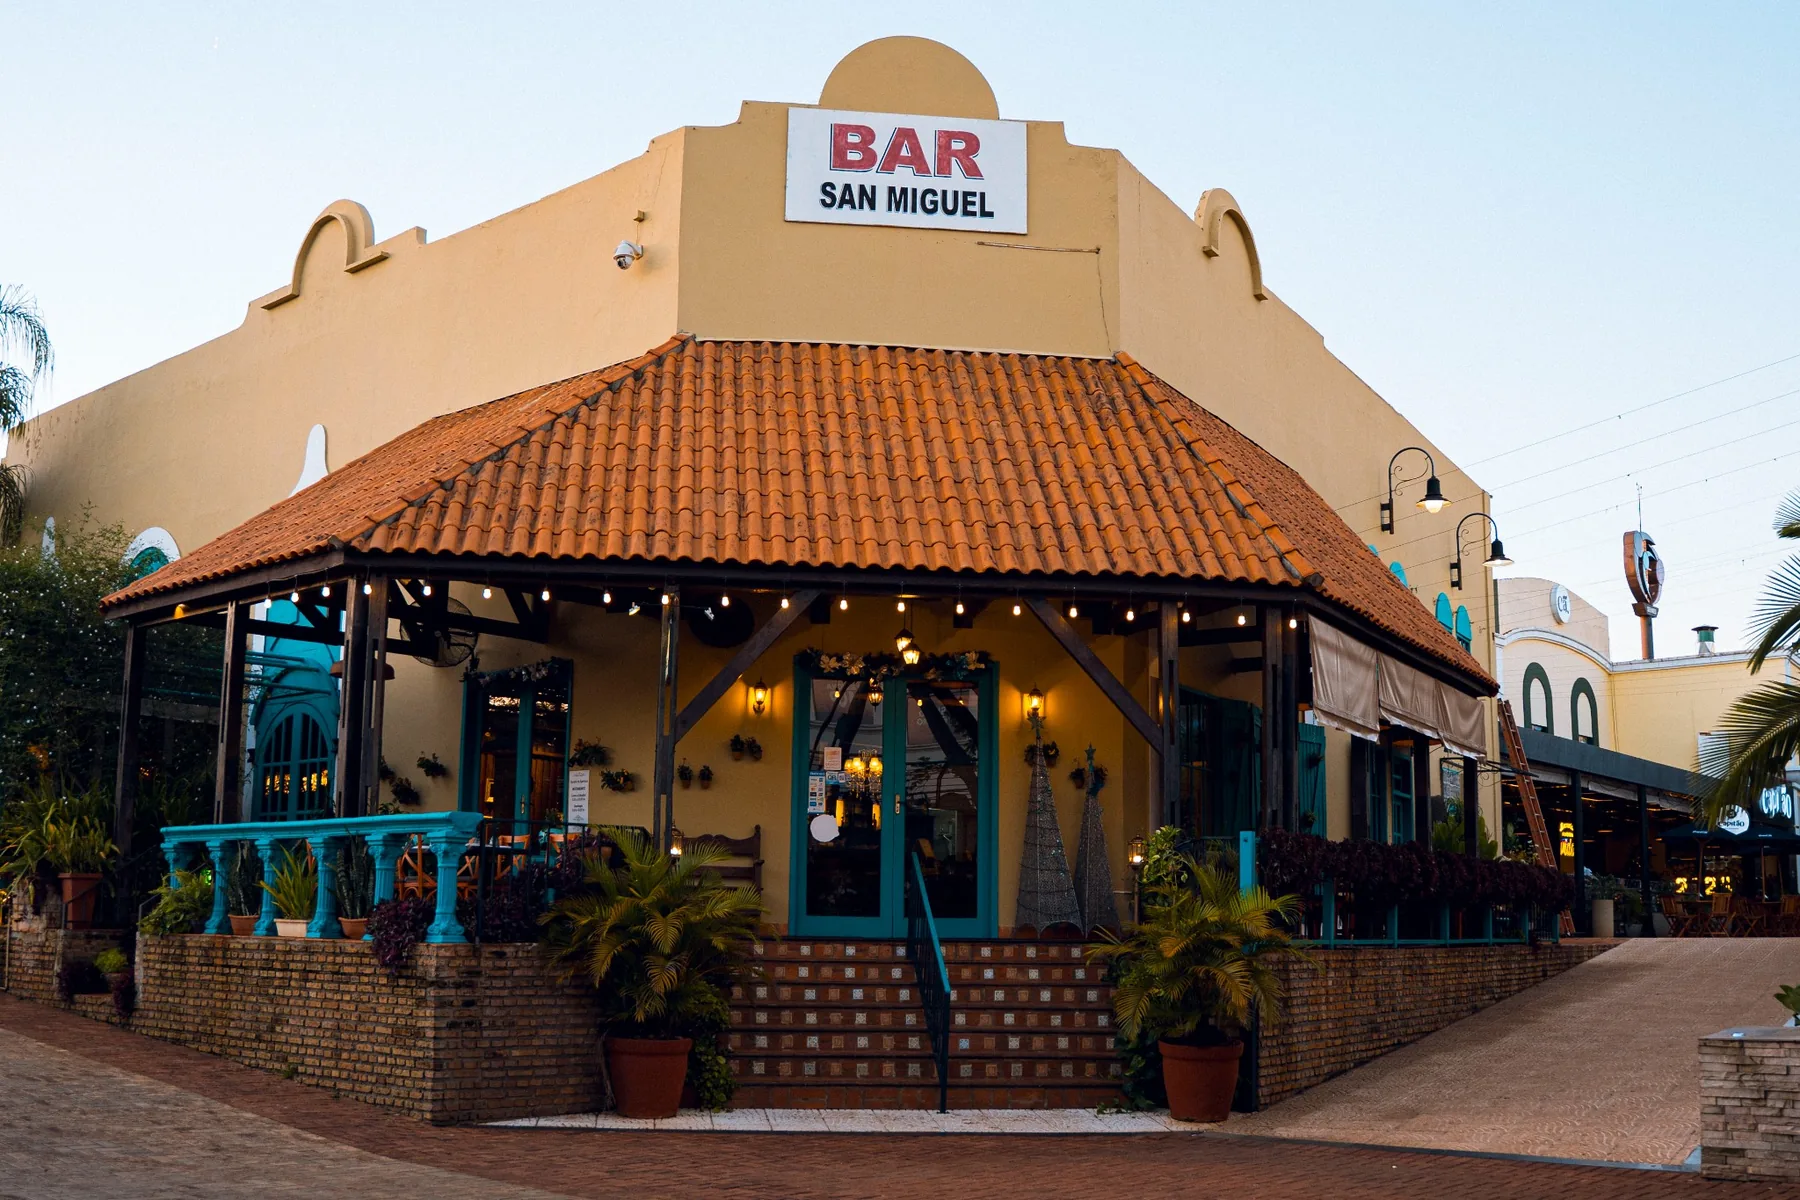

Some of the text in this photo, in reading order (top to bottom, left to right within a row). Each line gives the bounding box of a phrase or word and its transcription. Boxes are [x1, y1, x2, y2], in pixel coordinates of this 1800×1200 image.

[829, 123, 985, 180] BAR
[820, 182, 994, 218] SAN MIGUEL
